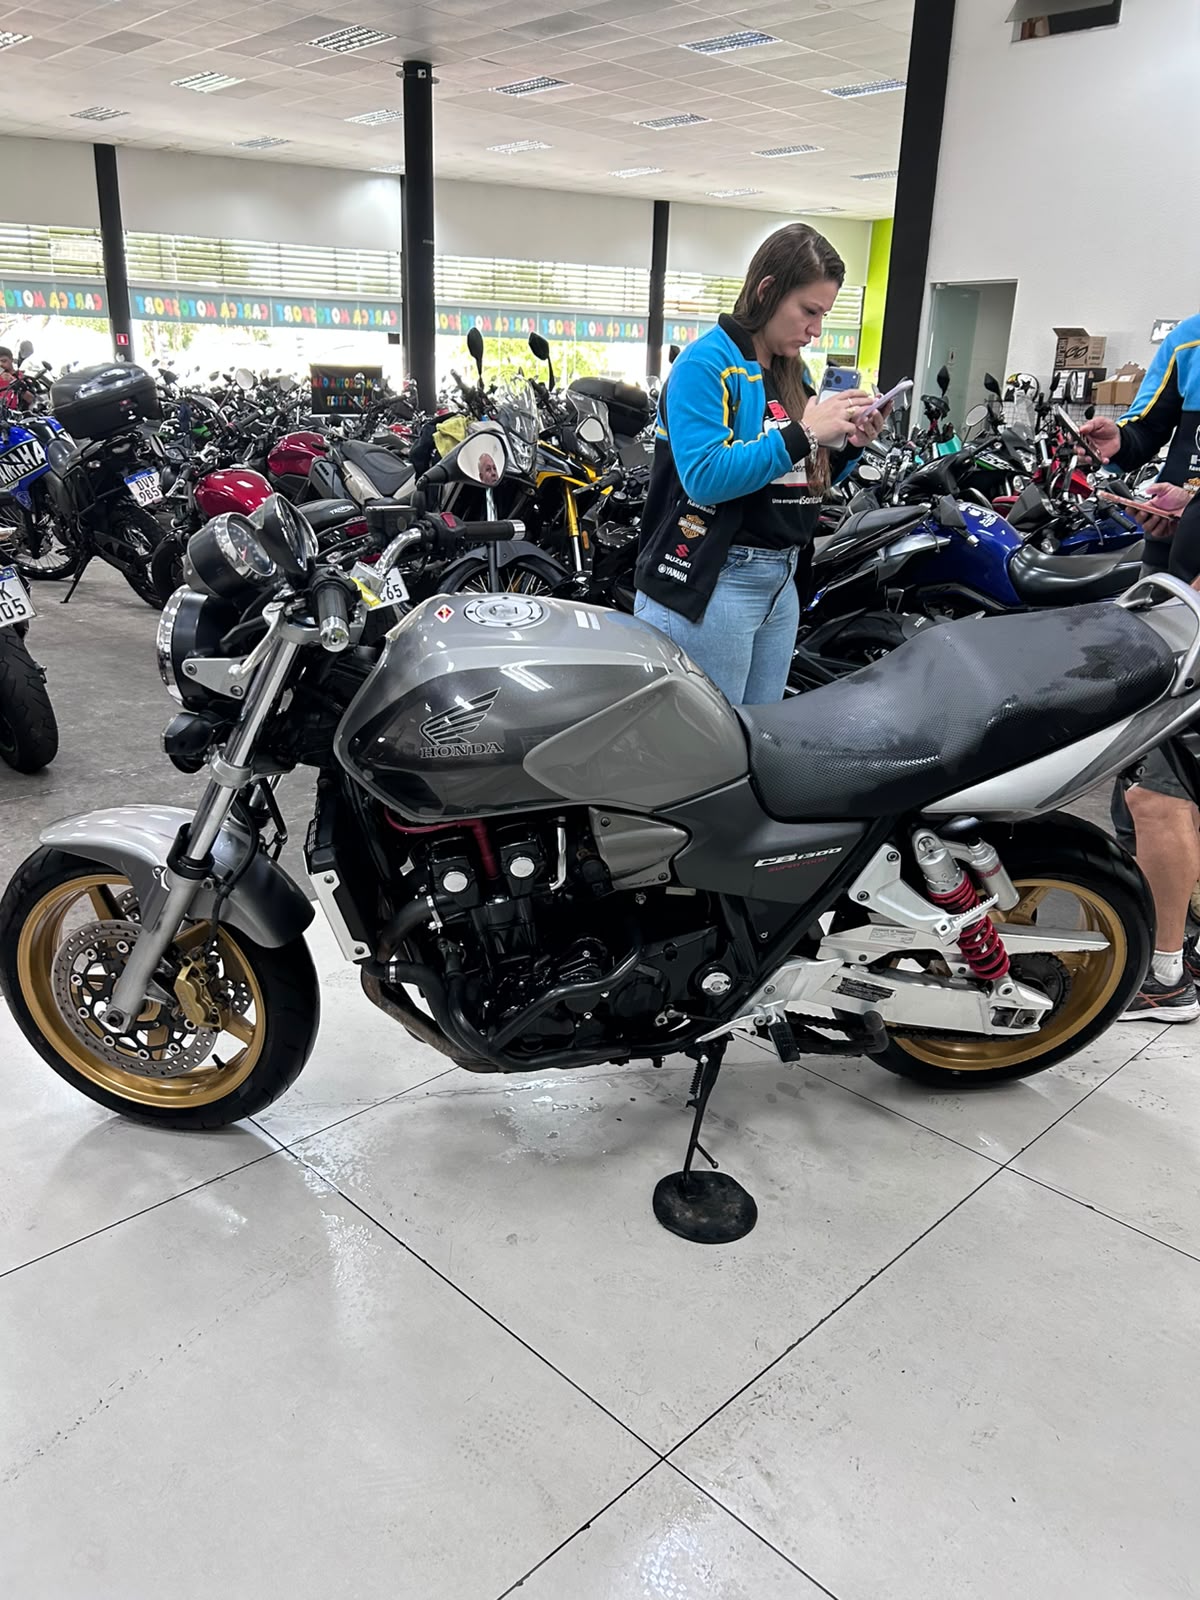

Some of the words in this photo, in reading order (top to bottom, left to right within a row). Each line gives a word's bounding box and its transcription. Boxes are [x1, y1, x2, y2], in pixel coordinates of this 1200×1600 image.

[0, 440, 47, 484] AMAHA
[135, 475, 155, 491] DVP
[664, 553, 692, 569] SUZUKI
[665, 566, 688, 583] YAMAHA
[0, 598, 26, 622] 05
[420, 742, 505, 758] HONDA
